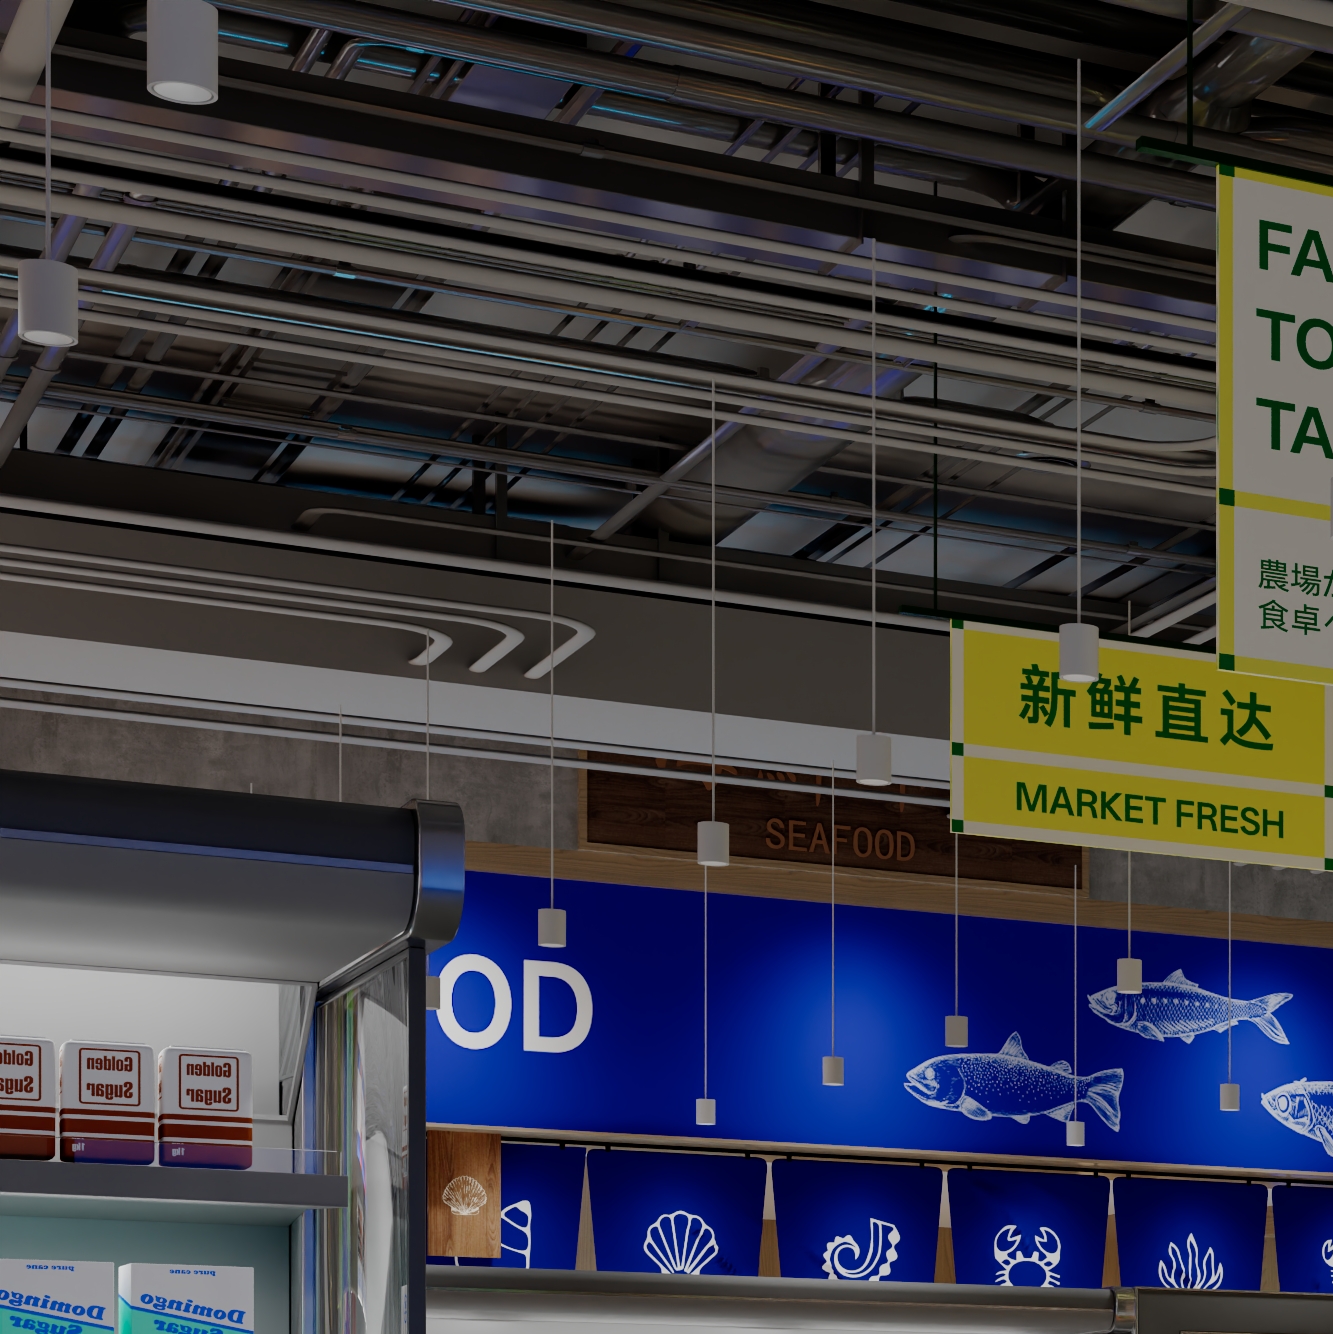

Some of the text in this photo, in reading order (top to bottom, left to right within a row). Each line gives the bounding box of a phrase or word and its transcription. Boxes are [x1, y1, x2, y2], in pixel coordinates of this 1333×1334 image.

[1019, 663, 1274, 751] 新鲜直达
[1016, 781, 1285, 839] MARKET FRESH
[765, 817, 916, 862] SEAFOOD
